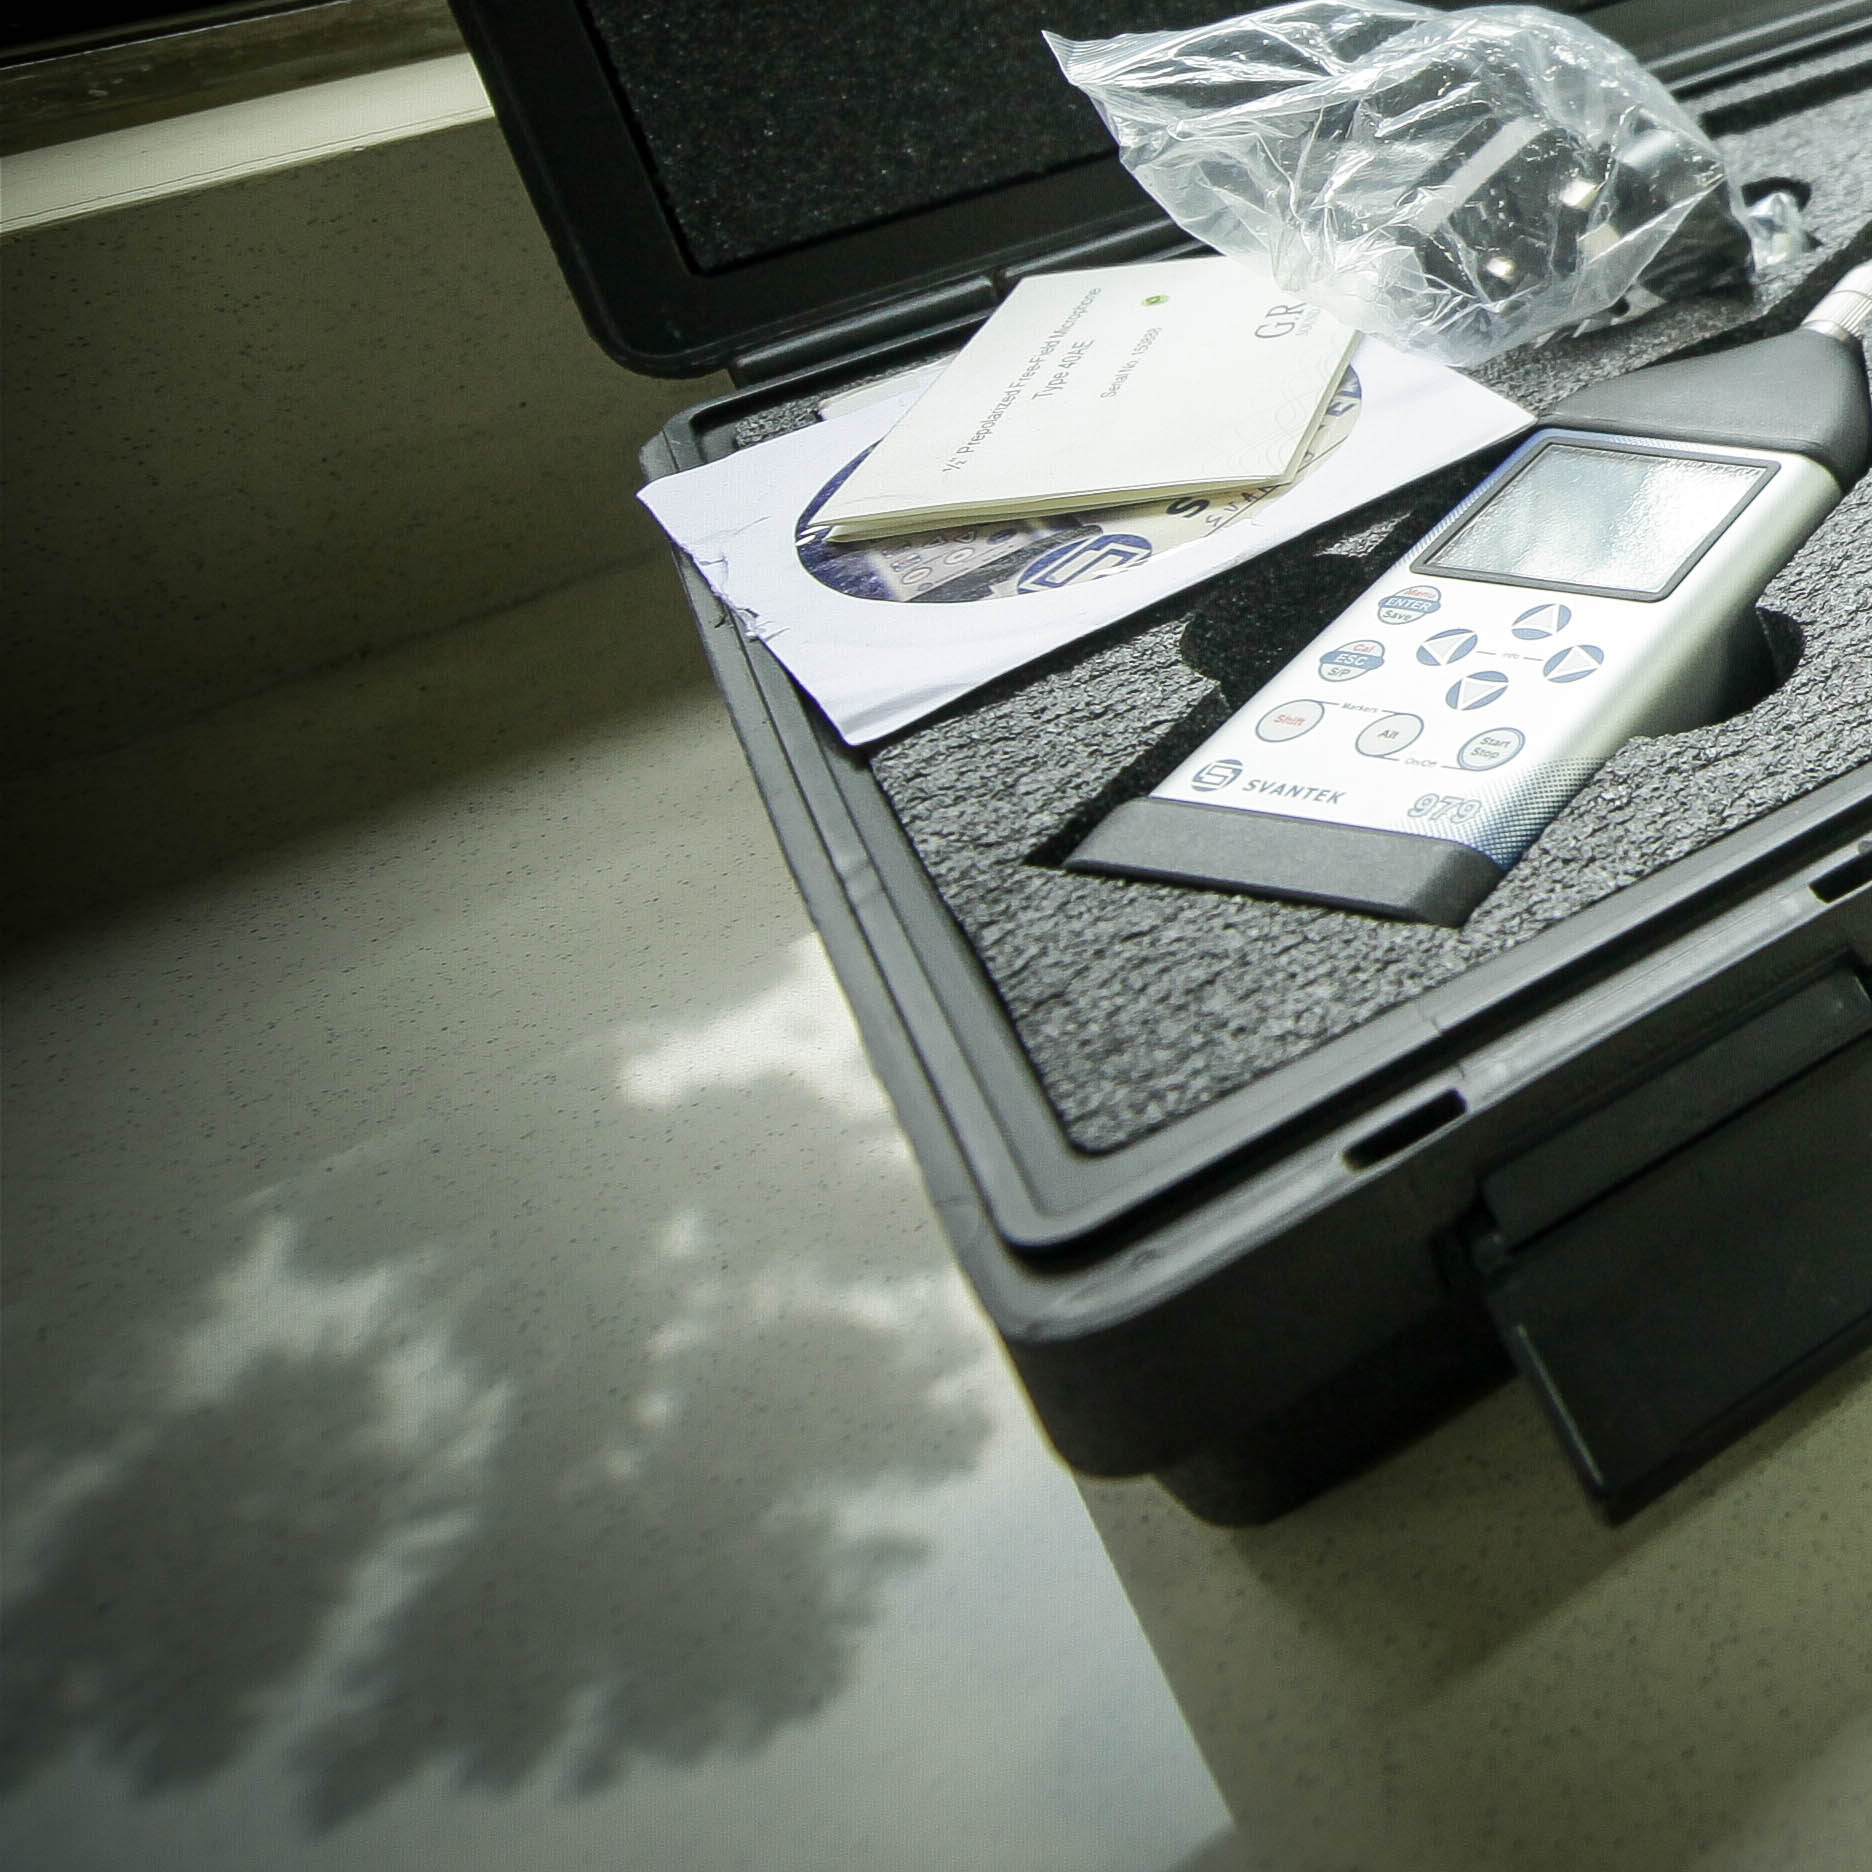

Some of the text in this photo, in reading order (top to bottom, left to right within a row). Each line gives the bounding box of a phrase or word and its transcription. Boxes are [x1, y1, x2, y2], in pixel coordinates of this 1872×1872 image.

[1031, 339, 1095, 401] Type 40AE
[1100, 373, 1129, 399] Serial
[956, 387, 1021, 456] Prepolarized
[1404, 588, 1436, 599] Menu
[1386, 597, 1433, 612] ENTER
[1382, 609, 1412, 621] Save
[1353, 643, 1375, 654] Cal
[1334, 653, 1369, 667] ESC
[1327, 667, 1351, 678] S/P
[1341, 702, 1380, 714] Markers
[1273, 714, 1306, 726] Shift
[1377, 728, 1399, 740] Alt
[1480, 736, 1511, 749] Start
[1470, 747, 1500, 760] Stop
[1242, 778, 1347, 805] SVANTEK
[1407, 792, 1482, 824] 979
